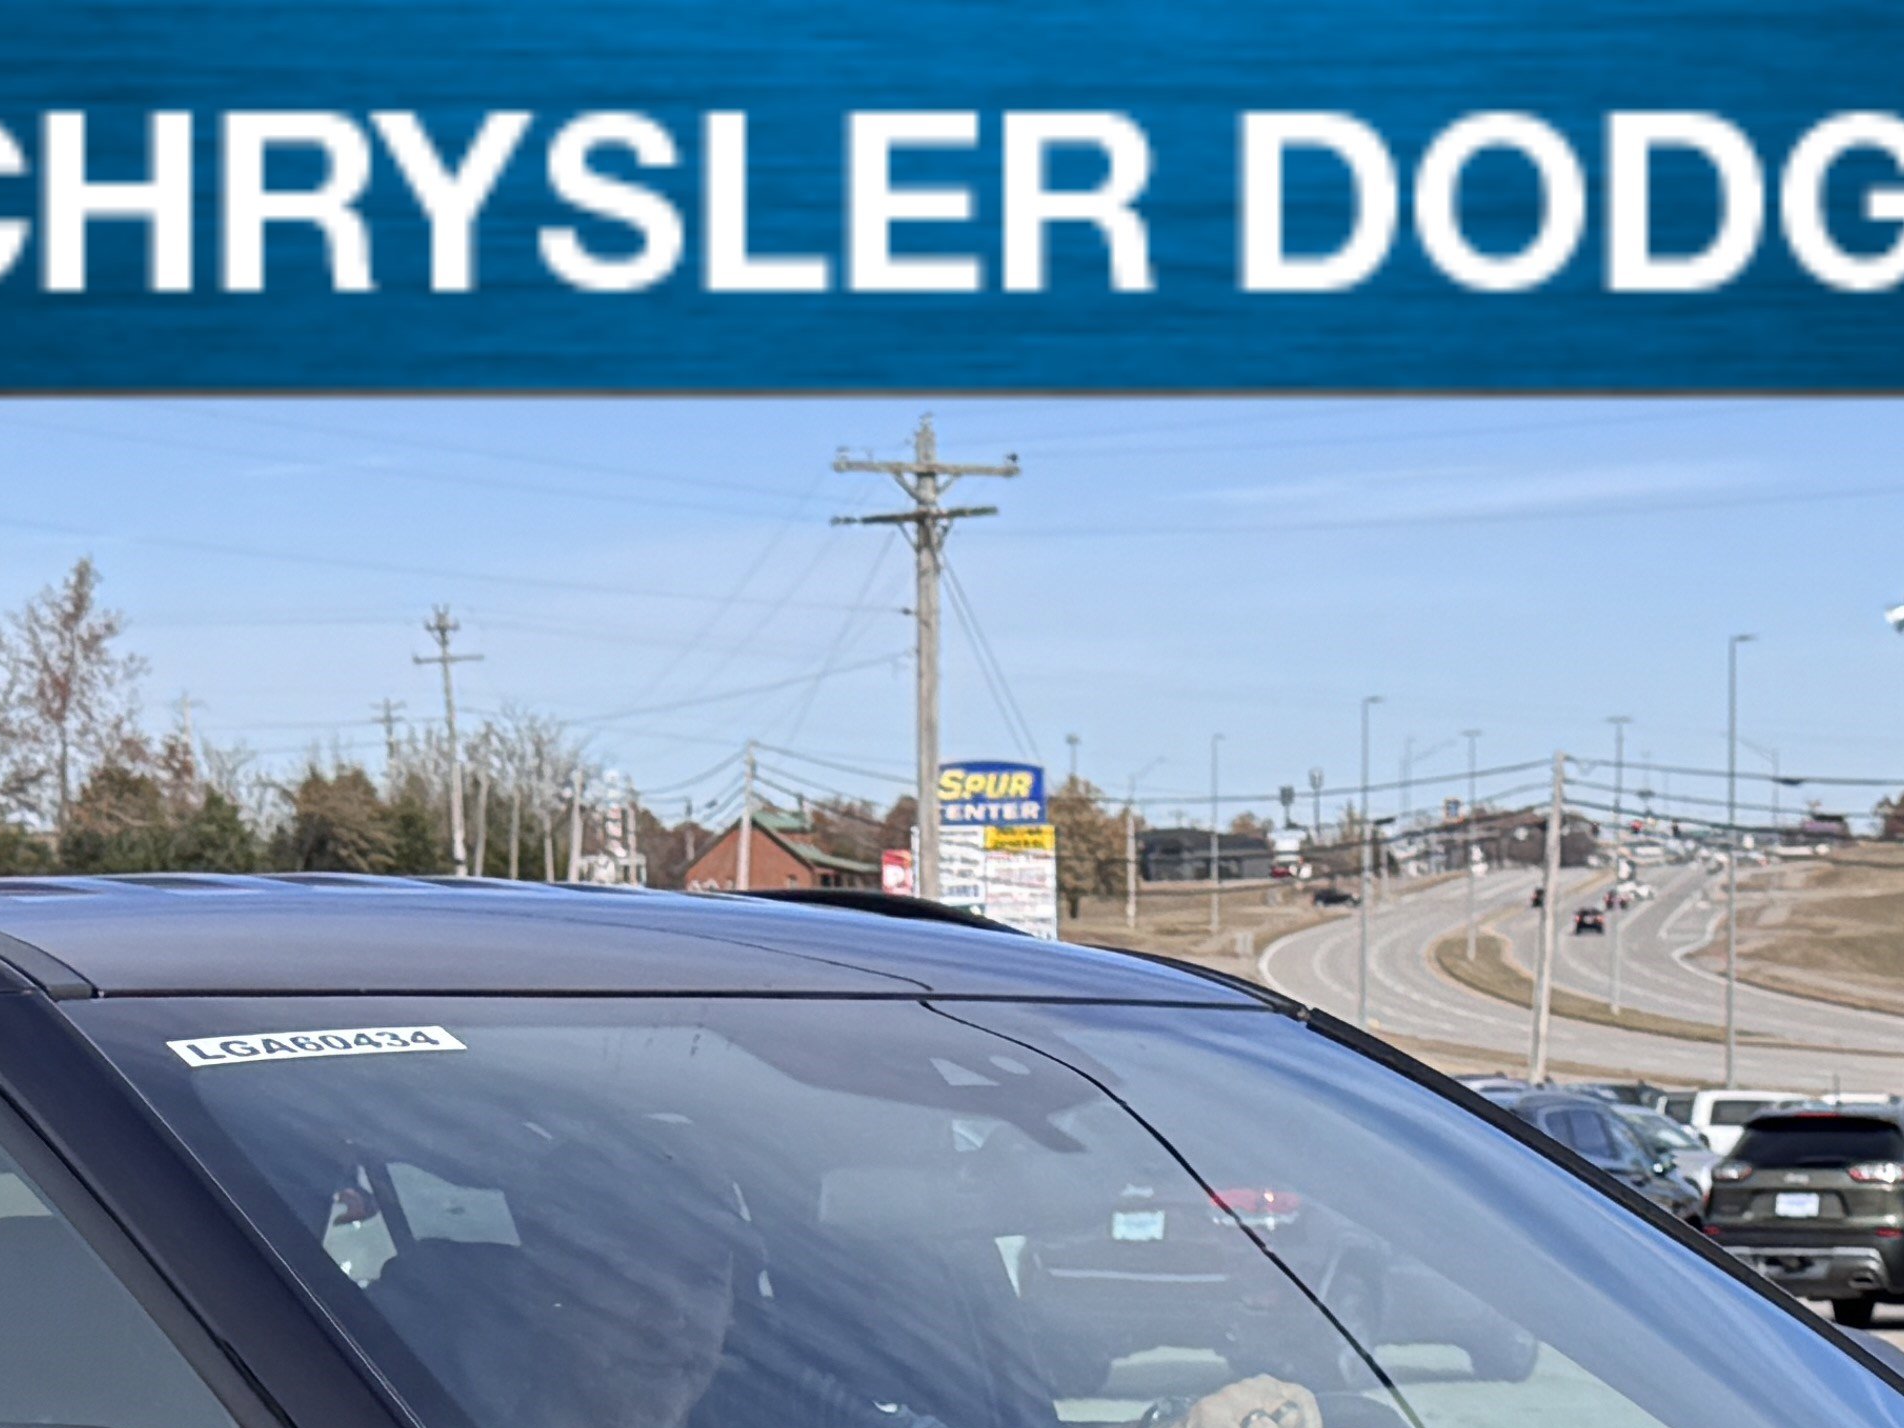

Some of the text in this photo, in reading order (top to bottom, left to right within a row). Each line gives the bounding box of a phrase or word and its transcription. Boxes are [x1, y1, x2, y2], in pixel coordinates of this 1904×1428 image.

[938, 768, 1034, 800] SPUR
[940, 802, 1040, 821] ENTER
[186, 1029, 440, 1062] LGA60434
